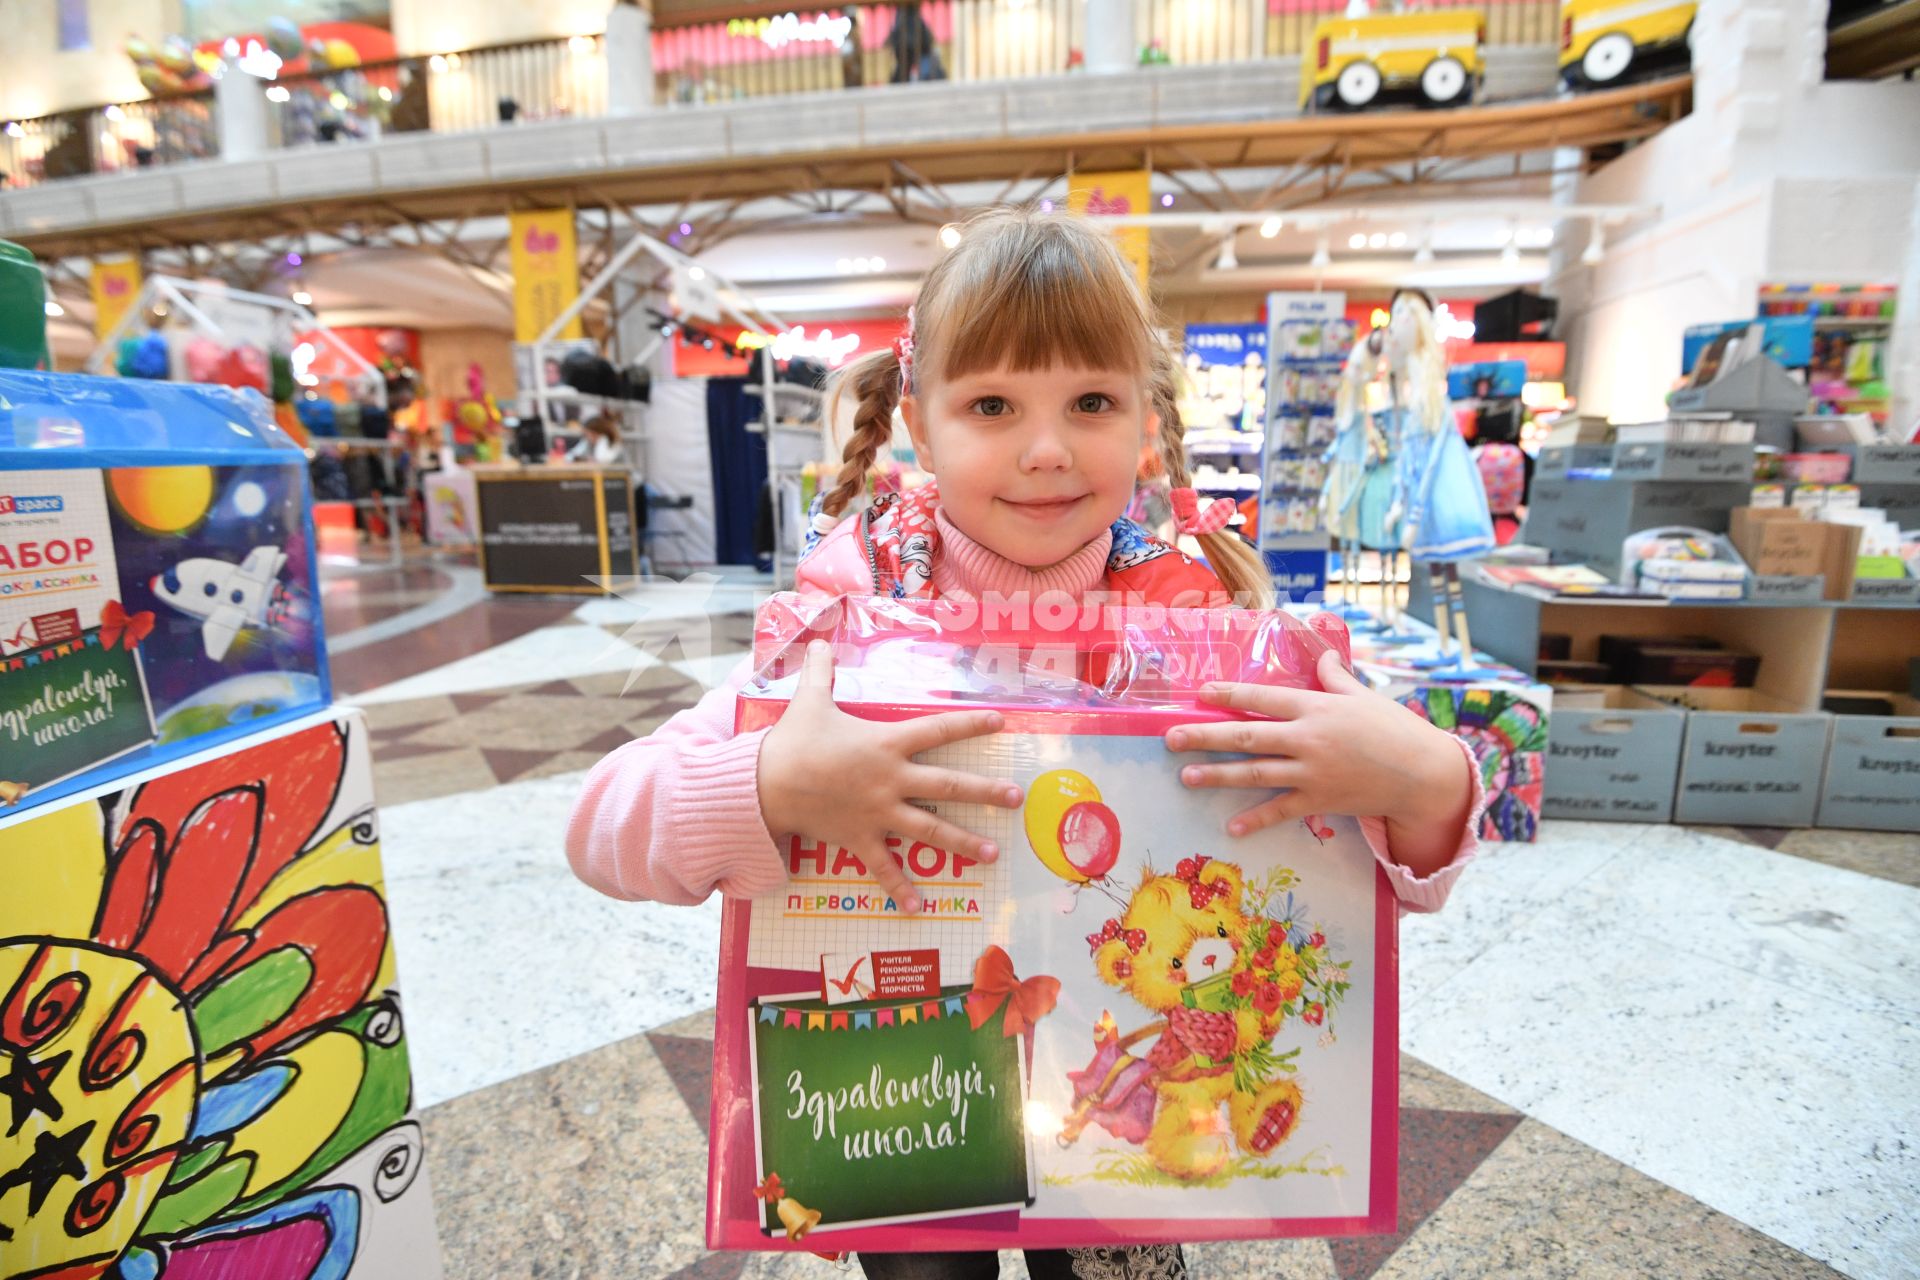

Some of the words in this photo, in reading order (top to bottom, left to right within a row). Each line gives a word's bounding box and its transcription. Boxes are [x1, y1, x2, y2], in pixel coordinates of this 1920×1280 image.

[787, 894, 979, 914] ПЕРВОКЛАНИКА
[880, 956, 912, 964] УЧИТЕЛЯ
[880, 964, 933, 974] РЕКОМЕНДУЮТ
[880, 976, 895, 985] ДЛЯ
[897, 974, 925, 984] УРОКОВ
[881, 984, 925, 994] ТВОРЧЕСТВА
[787, 1054, 995, 1141] Здравствуй,
[843, 1098, 968, 1161] школа!
